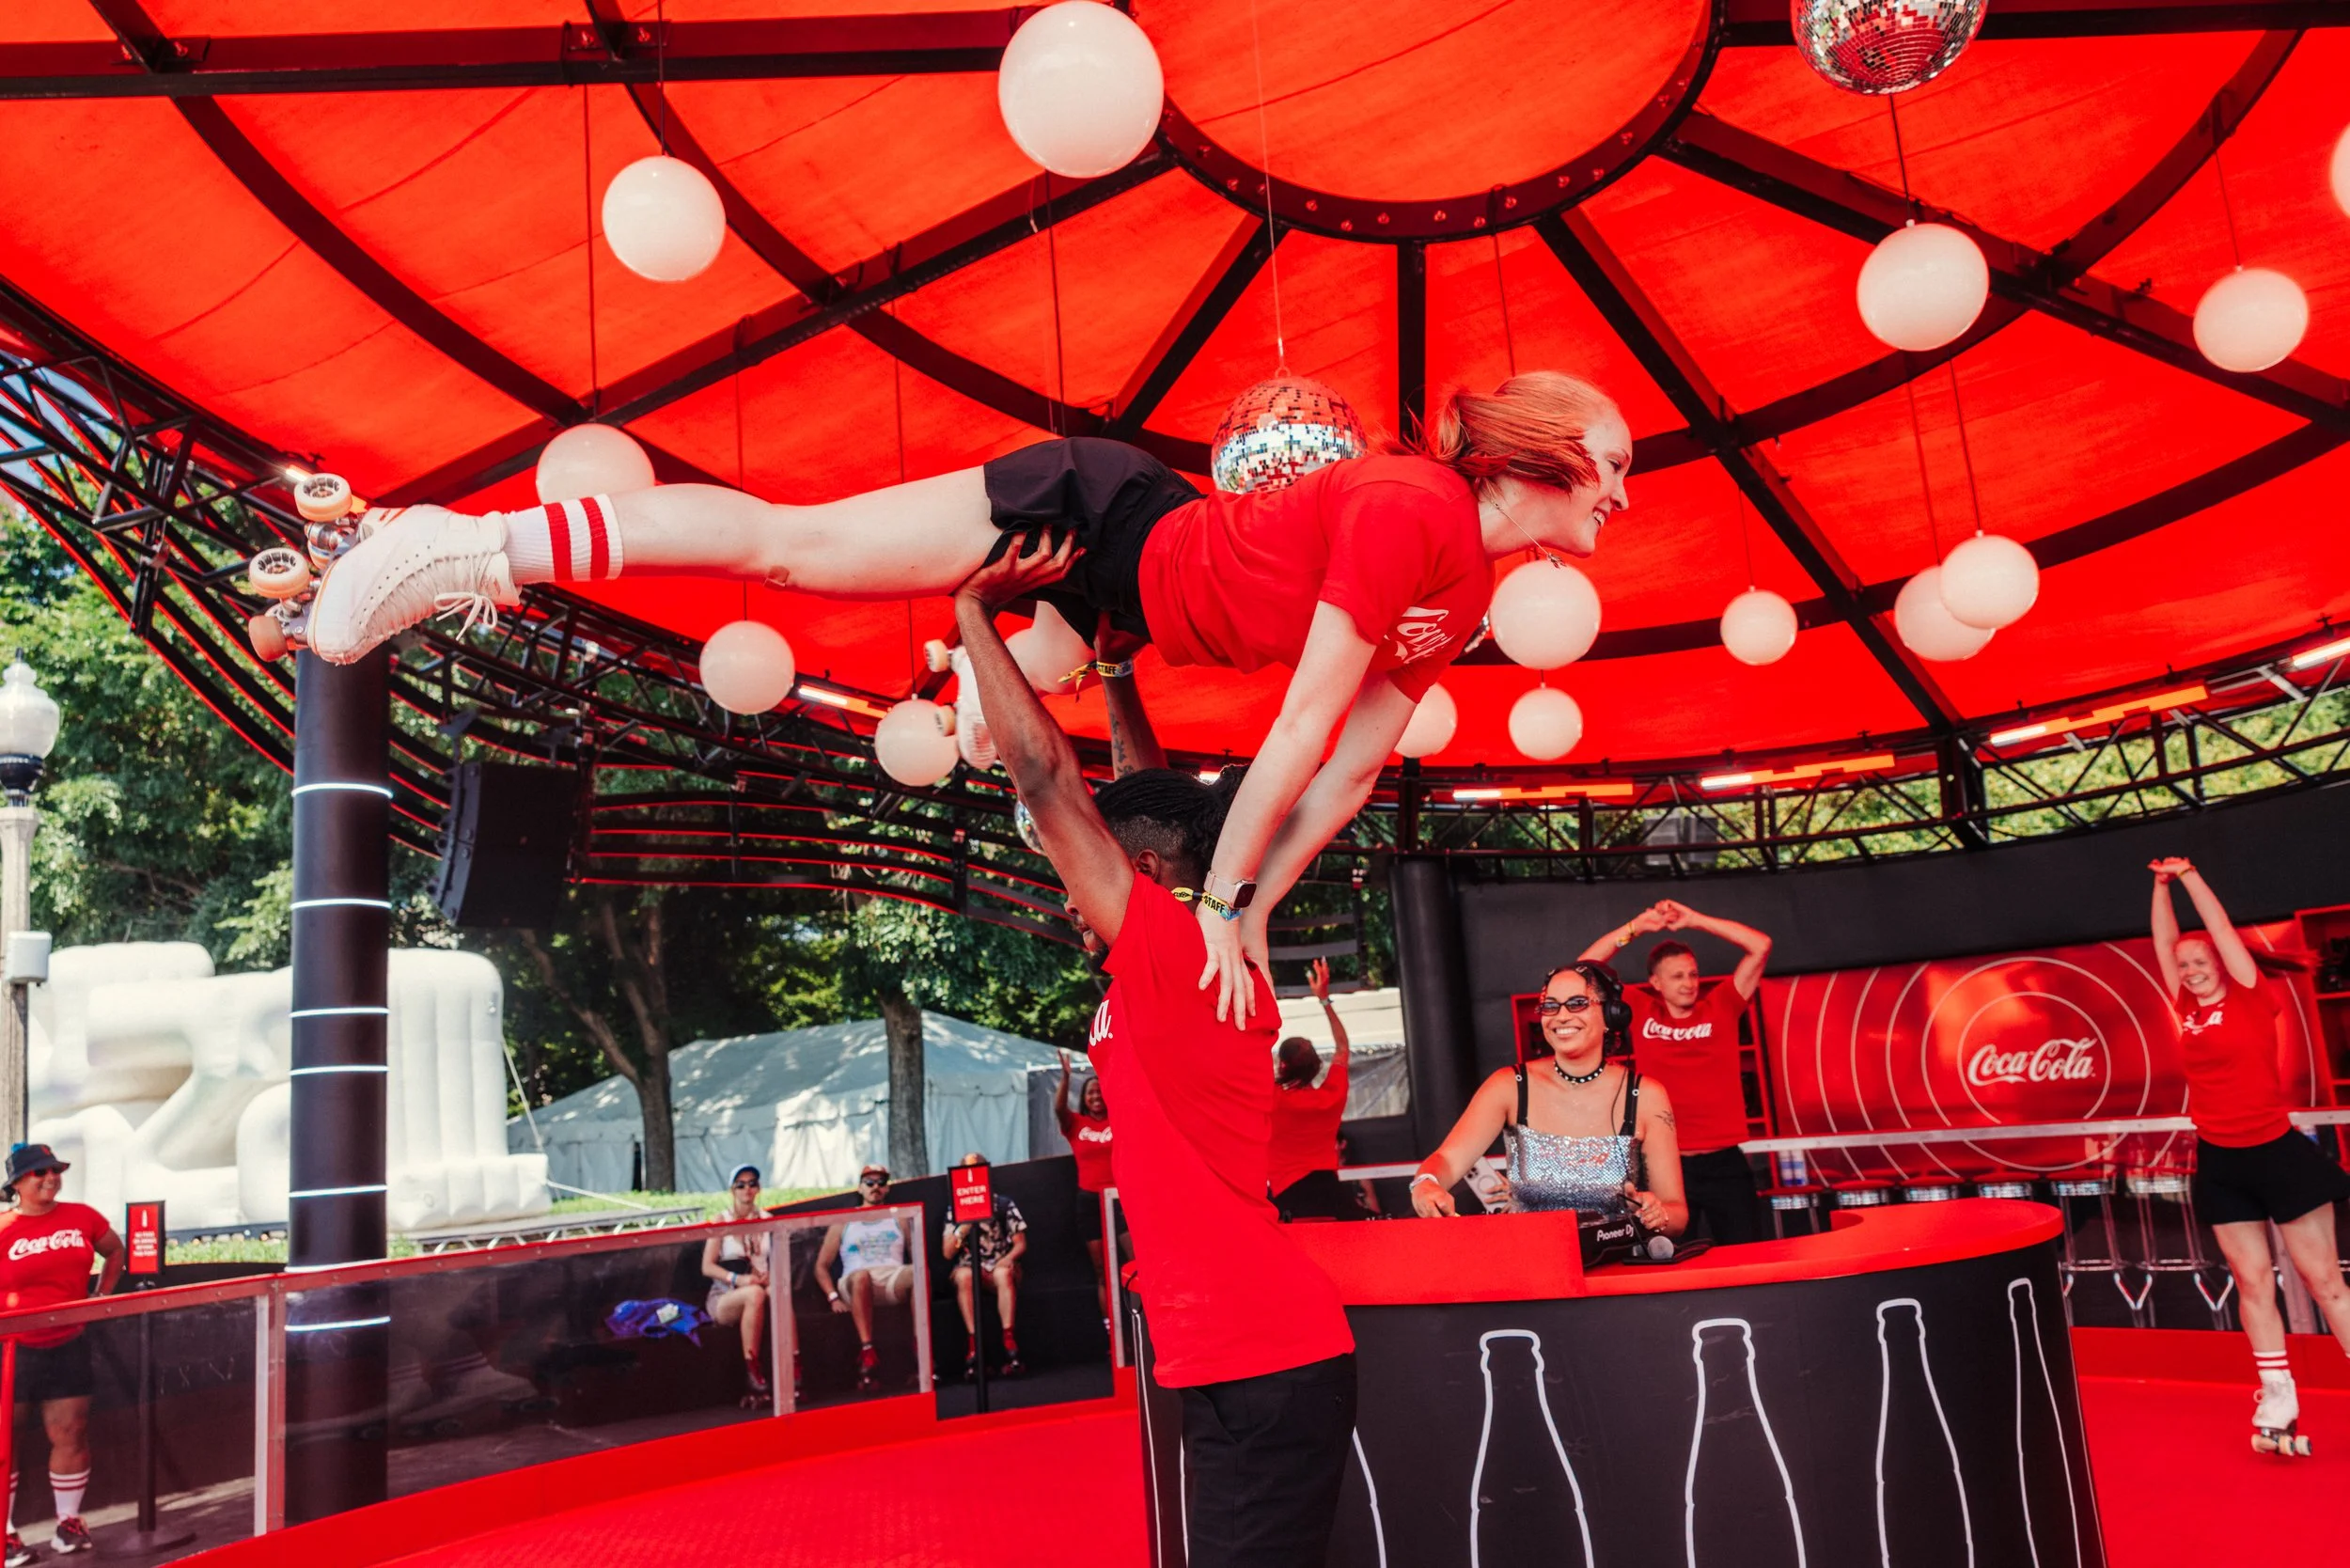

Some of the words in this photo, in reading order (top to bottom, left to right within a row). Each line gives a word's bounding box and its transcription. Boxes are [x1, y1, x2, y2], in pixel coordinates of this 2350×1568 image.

[1203, 895, 1225, 914] STAFF
[1967, 1037, 2097, 1087] Coca-Cola
[956, 1184, 986, 1197] ENTER
[960, 1194, 985, 1206] HERE
[1596, 1229, 1624, 1242] Pioneer
[8, 1228, 86, 1261] Coca-Cola
